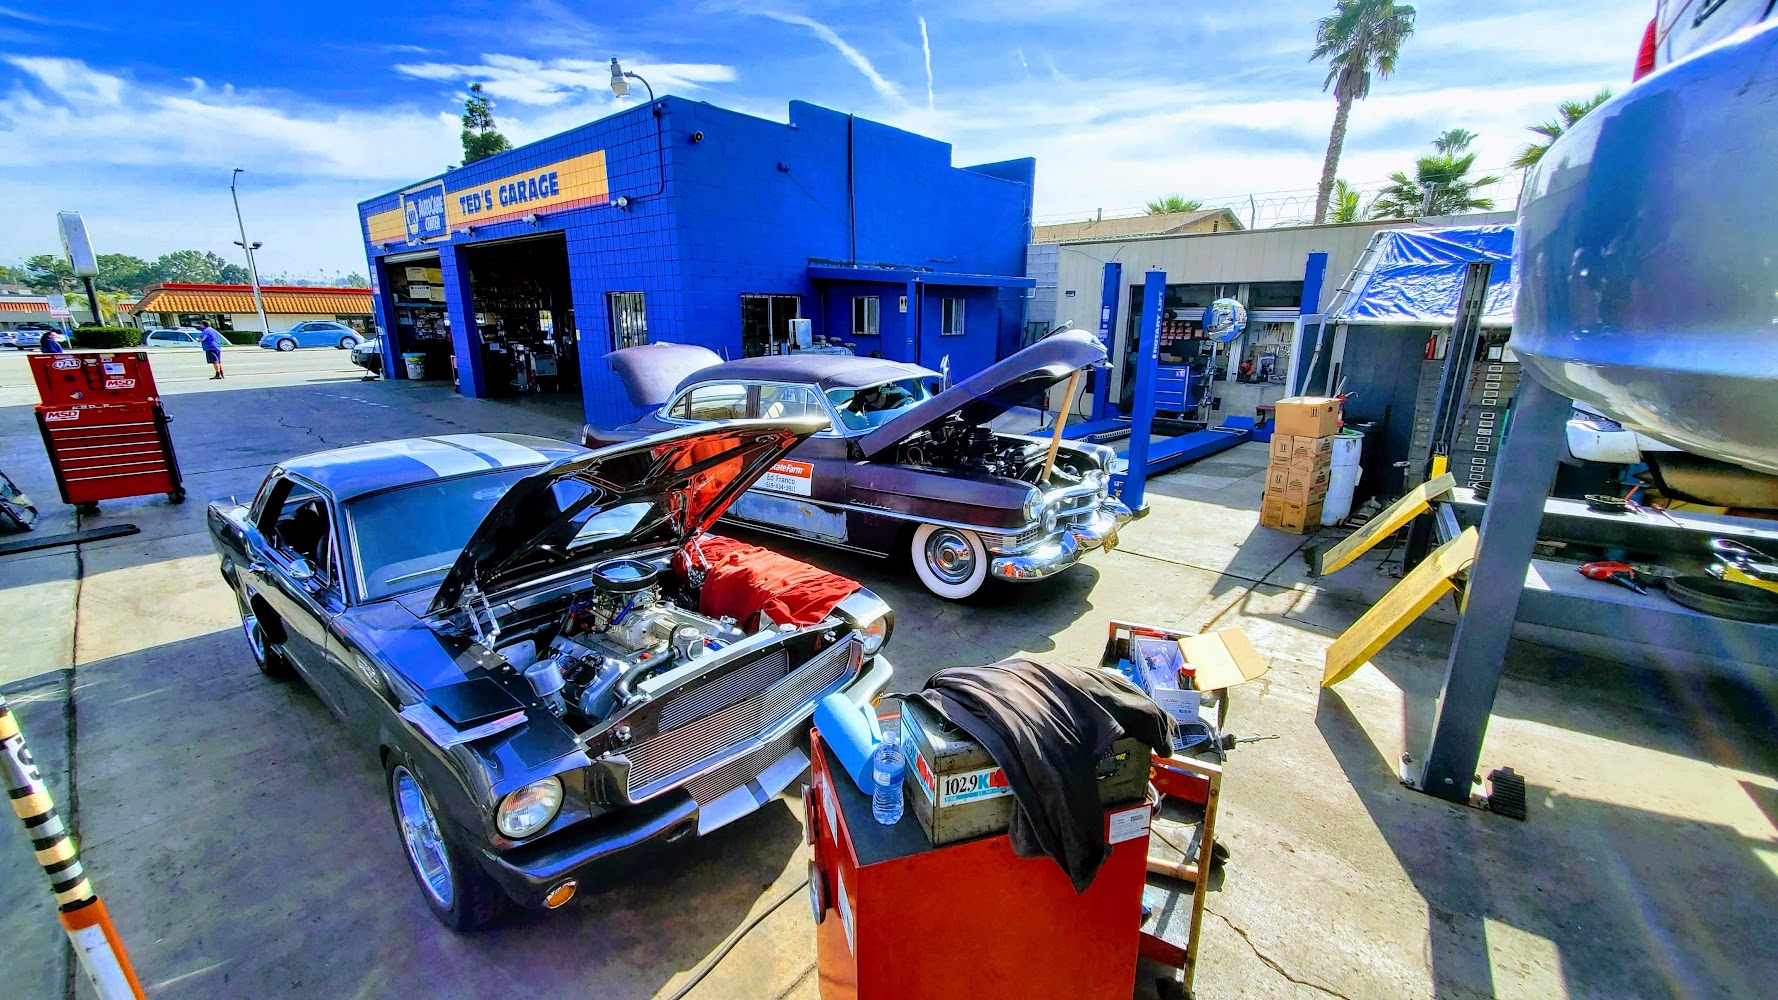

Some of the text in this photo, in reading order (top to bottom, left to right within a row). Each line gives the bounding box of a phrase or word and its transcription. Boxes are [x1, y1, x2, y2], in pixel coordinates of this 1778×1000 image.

[459, 171, 560, 216] TED'S GARAGE
[1153, 314, 1161, 354] ROTARY
[766, 473, 796, 485] Ed Franco
